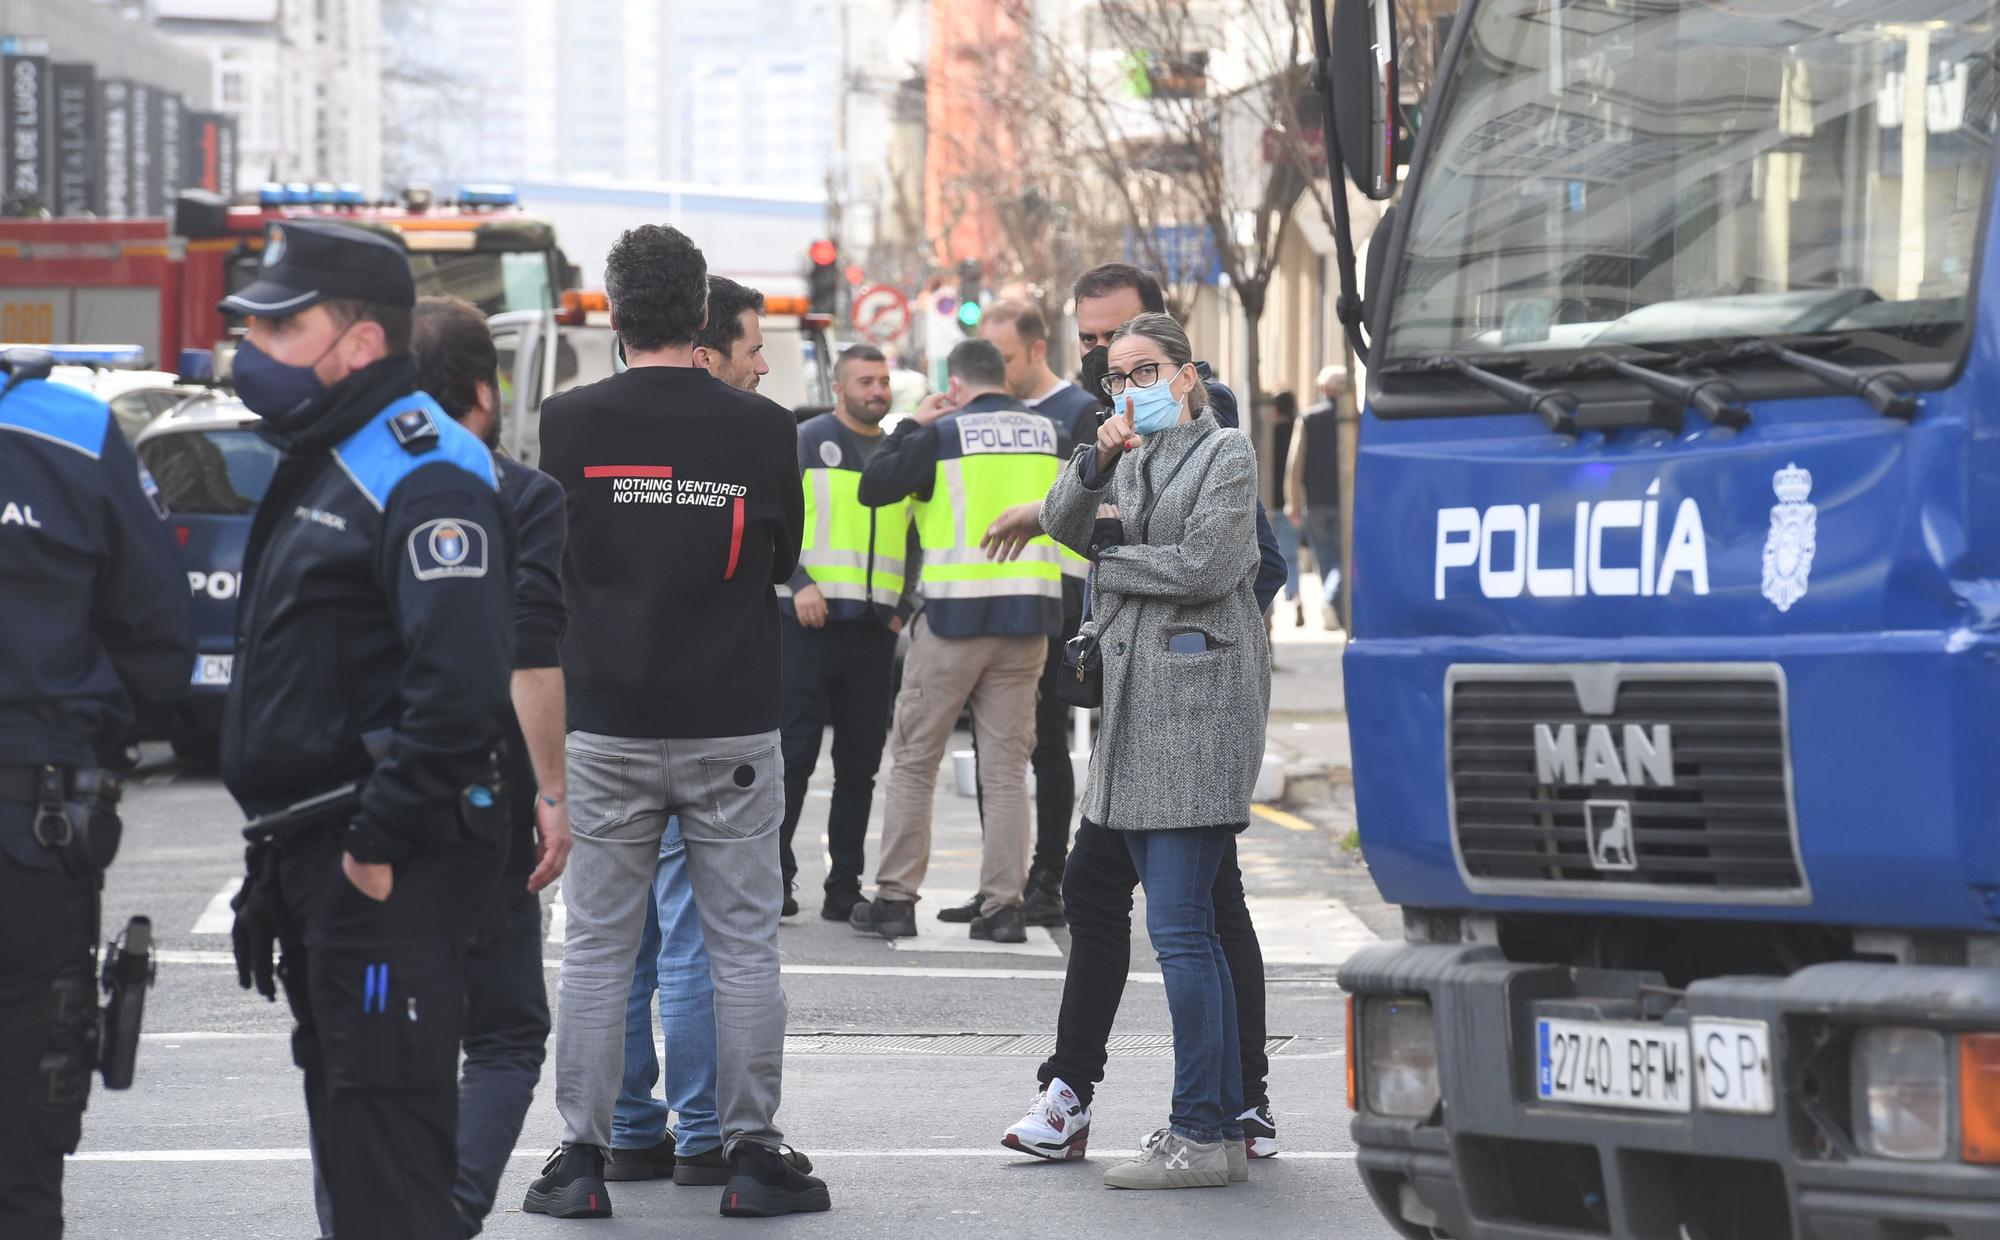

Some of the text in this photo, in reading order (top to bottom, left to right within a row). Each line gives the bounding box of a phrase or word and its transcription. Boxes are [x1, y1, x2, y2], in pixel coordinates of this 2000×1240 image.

[965, 429, 1053, 448] POLICIA
[613, 479, 747, 497] NOTHING VENTURED
[613, 492, 726, 507] NOTHING GAINED
[1435, 477, 1710, 600] POLICÍA
[1534, 723, 1675, 787] MAN
[1554, 1033, 1612, 1094] 2740
